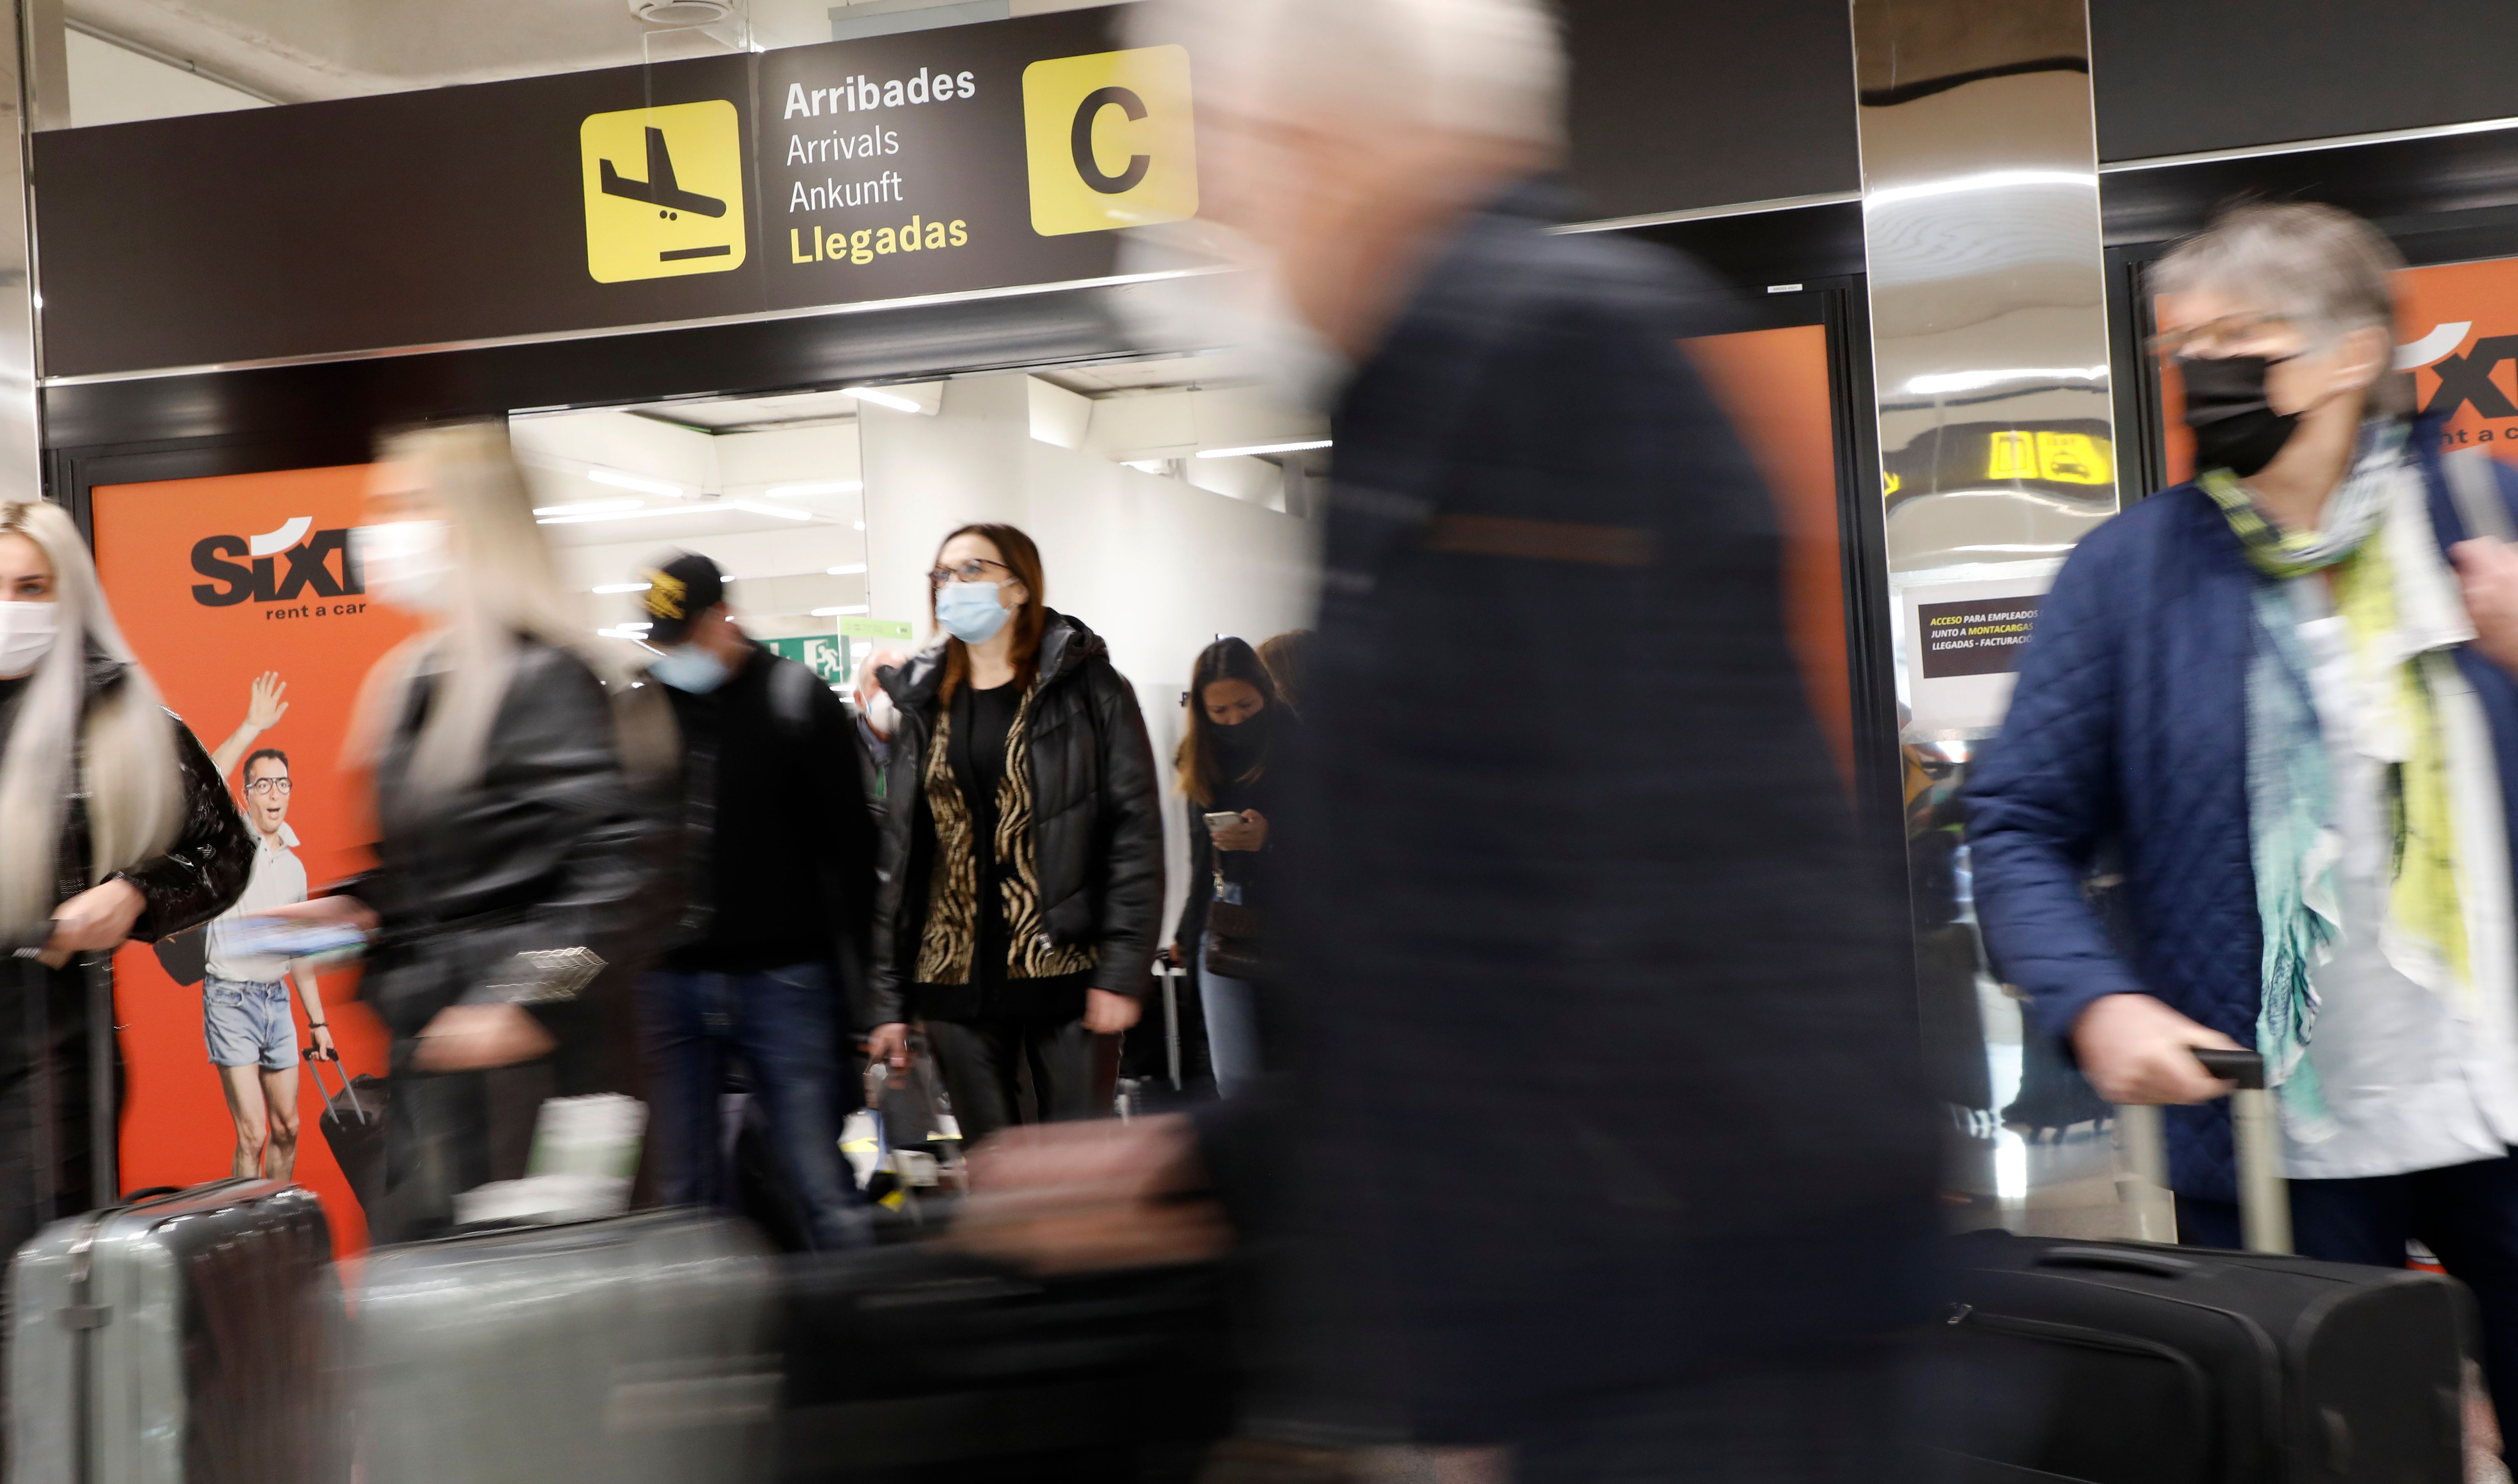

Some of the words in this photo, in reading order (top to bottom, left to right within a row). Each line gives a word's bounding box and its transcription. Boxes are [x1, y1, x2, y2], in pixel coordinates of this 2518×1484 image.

[784, 67, 976, 120] Arribades
[787, 125, 899, 166] Arrivals
[1071, 85, 1151, 195] C
[789, 171, 903, 213] Ankunft
[791, 214, 969, 266] Llegadas
[2441, 429, 2468, 444] nt
[2479, 429, 2494, 442] a
[266, 605, 309, 620] rent
[316, 606, 327, 617] a
[333, 604, 366, 616] car
[1930, 616, 1962, 626] ACCESO
[1964, 614, 1986, 624] PARA
[1988, 610, 2038, 622] EMPLEADOS
[1931, 628, 1958, 638] JUNTO
[1959, 628, 1967, 636] A
[1968, 623, 2034, 635] MONTACARGAS
[1932, 640, 1974, 651] LLEGADAS
